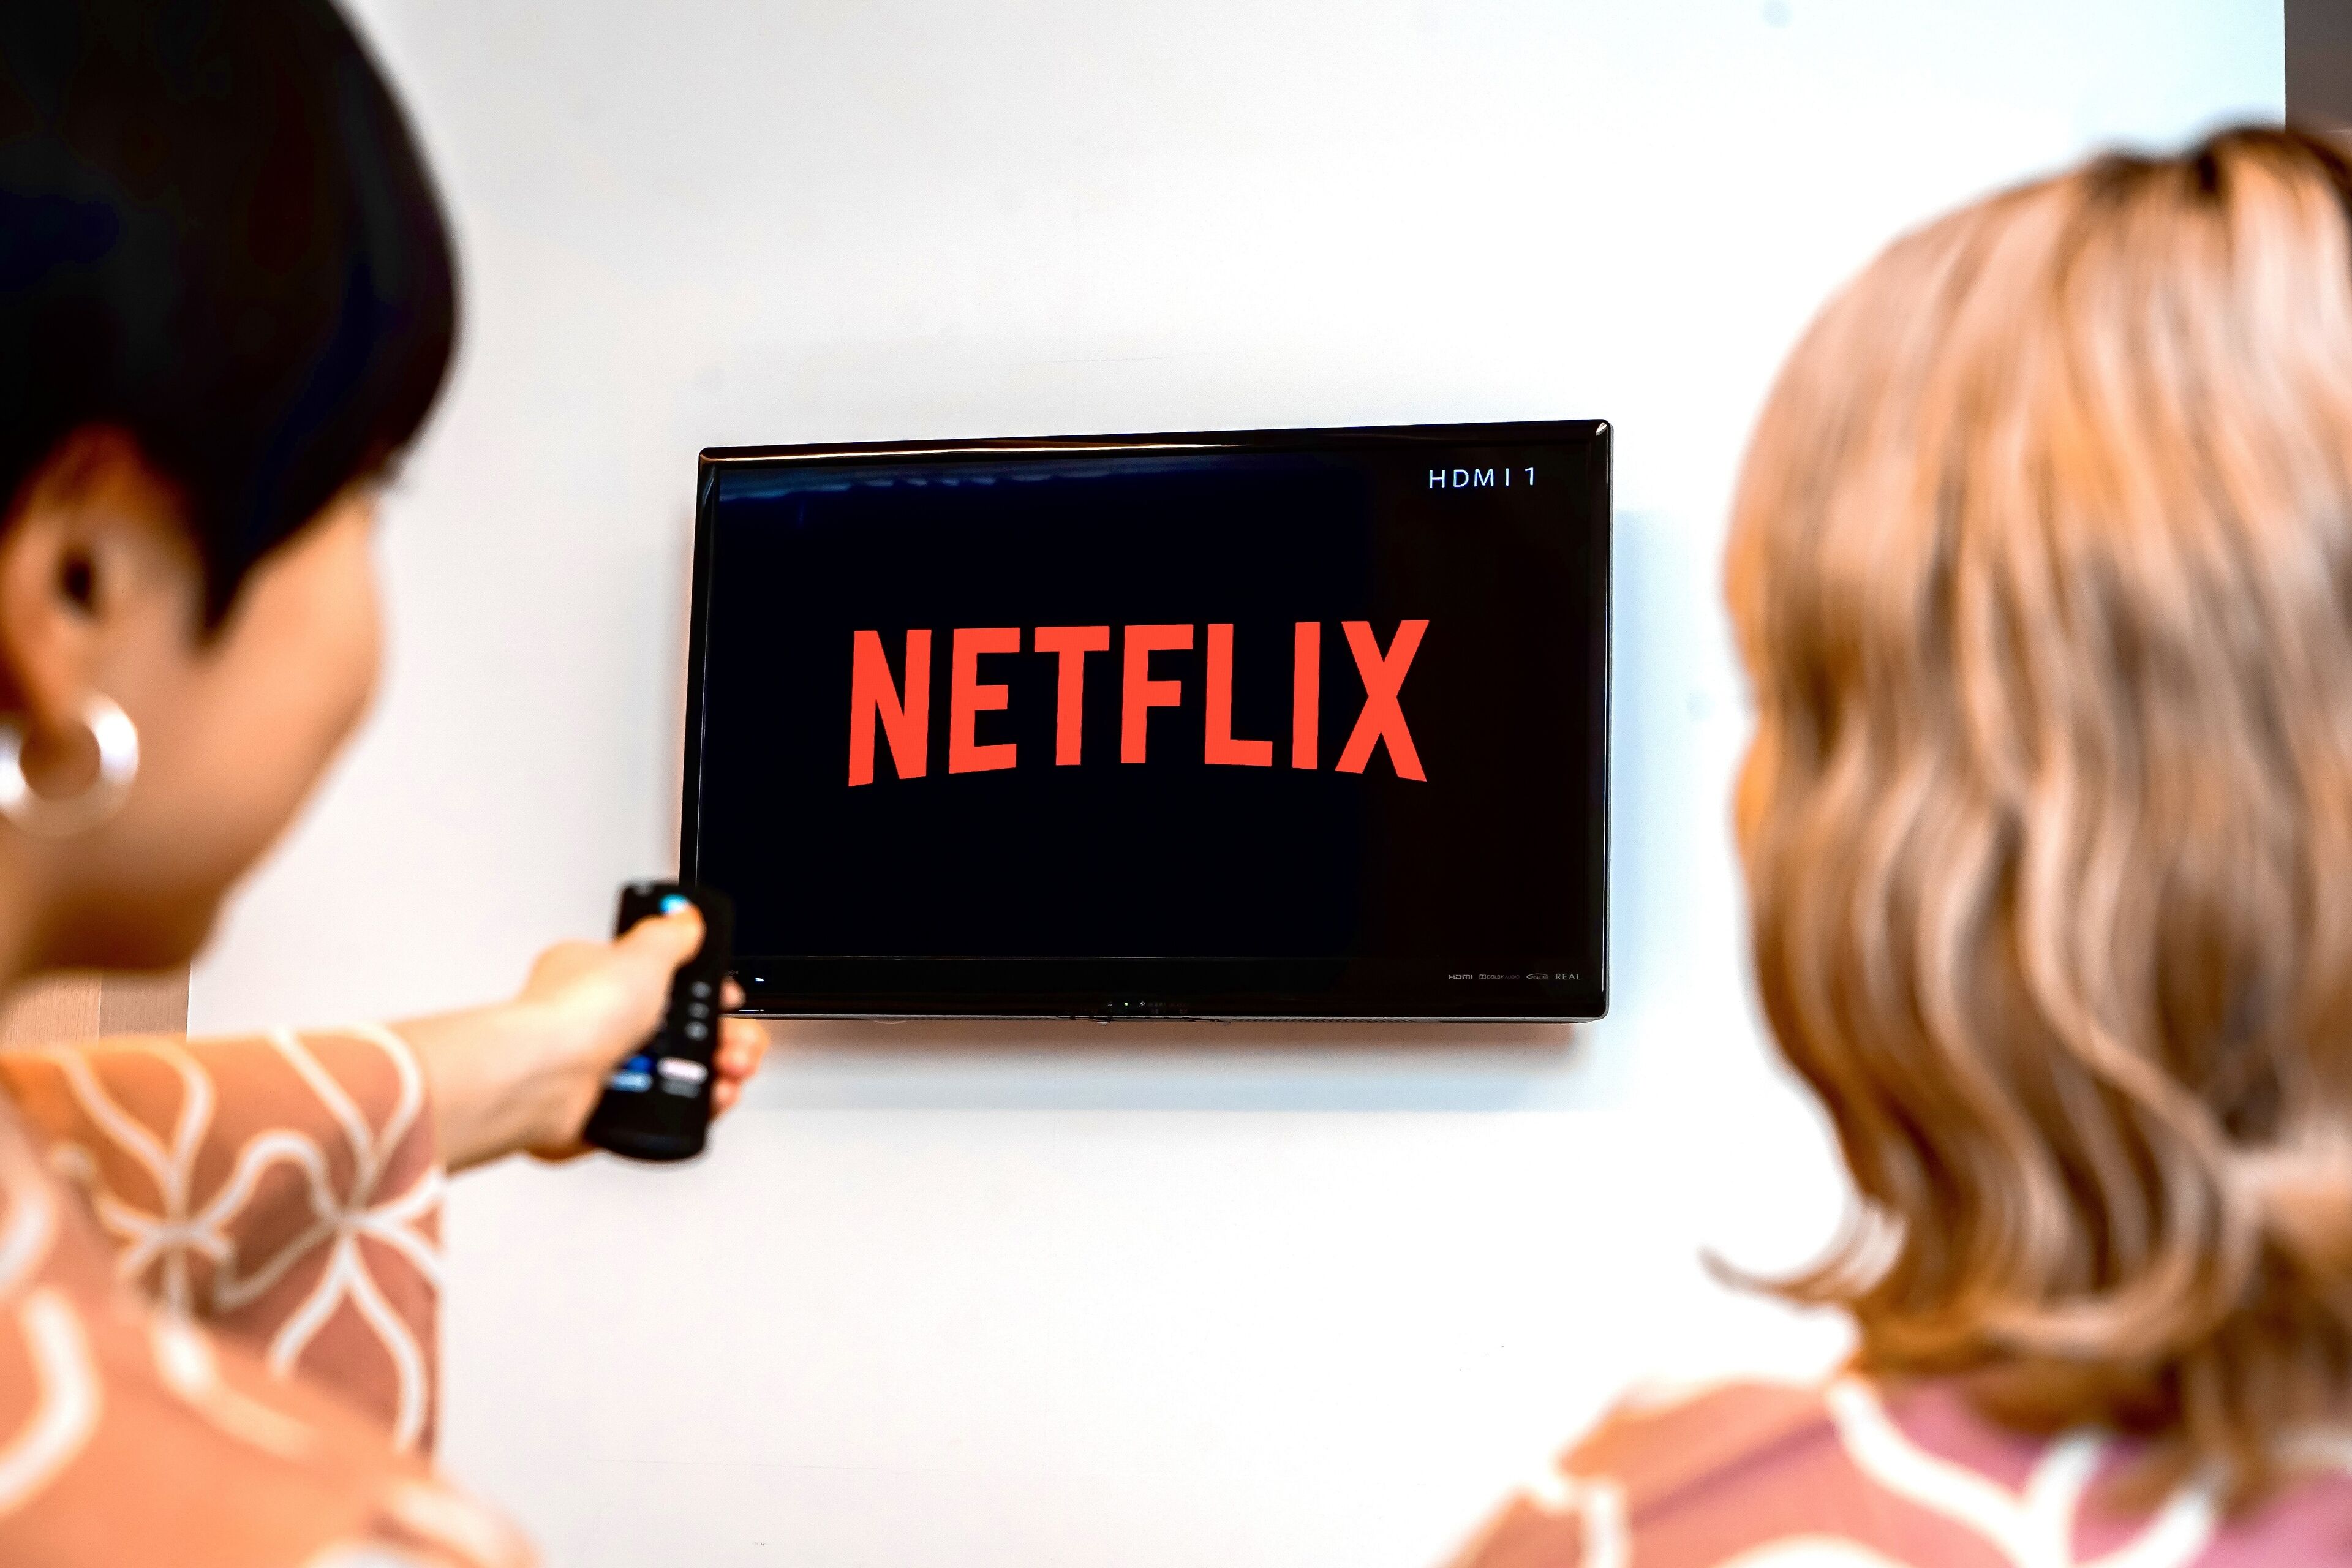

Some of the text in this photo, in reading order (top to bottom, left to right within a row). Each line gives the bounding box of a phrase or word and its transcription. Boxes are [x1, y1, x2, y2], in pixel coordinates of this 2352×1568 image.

[1429, 467, 1534, 488] HDMI 1
[848, 620, 1430, 787] NETFLIX
